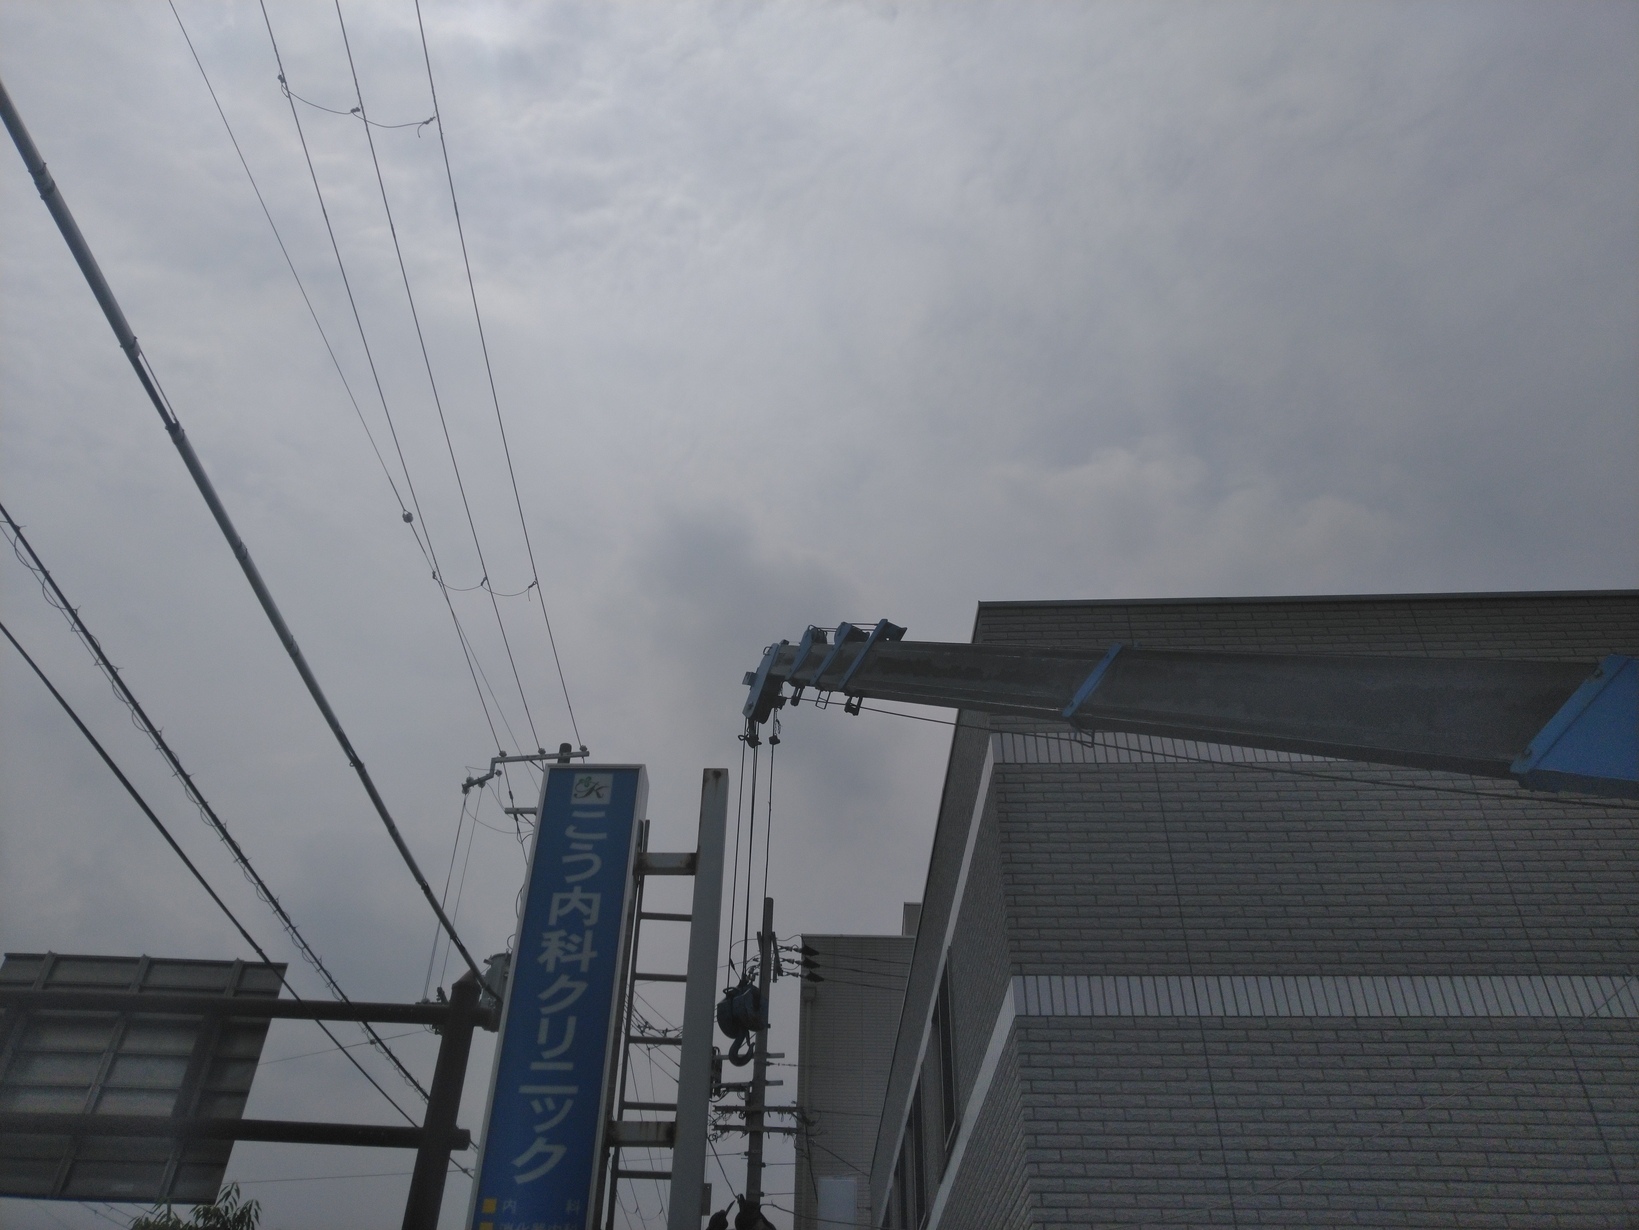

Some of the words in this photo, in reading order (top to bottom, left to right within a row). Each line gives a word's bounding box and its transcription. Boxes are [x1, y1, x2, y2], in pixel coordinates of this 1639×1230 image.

[512, 811, 608, 1185] こう内科クリニック
